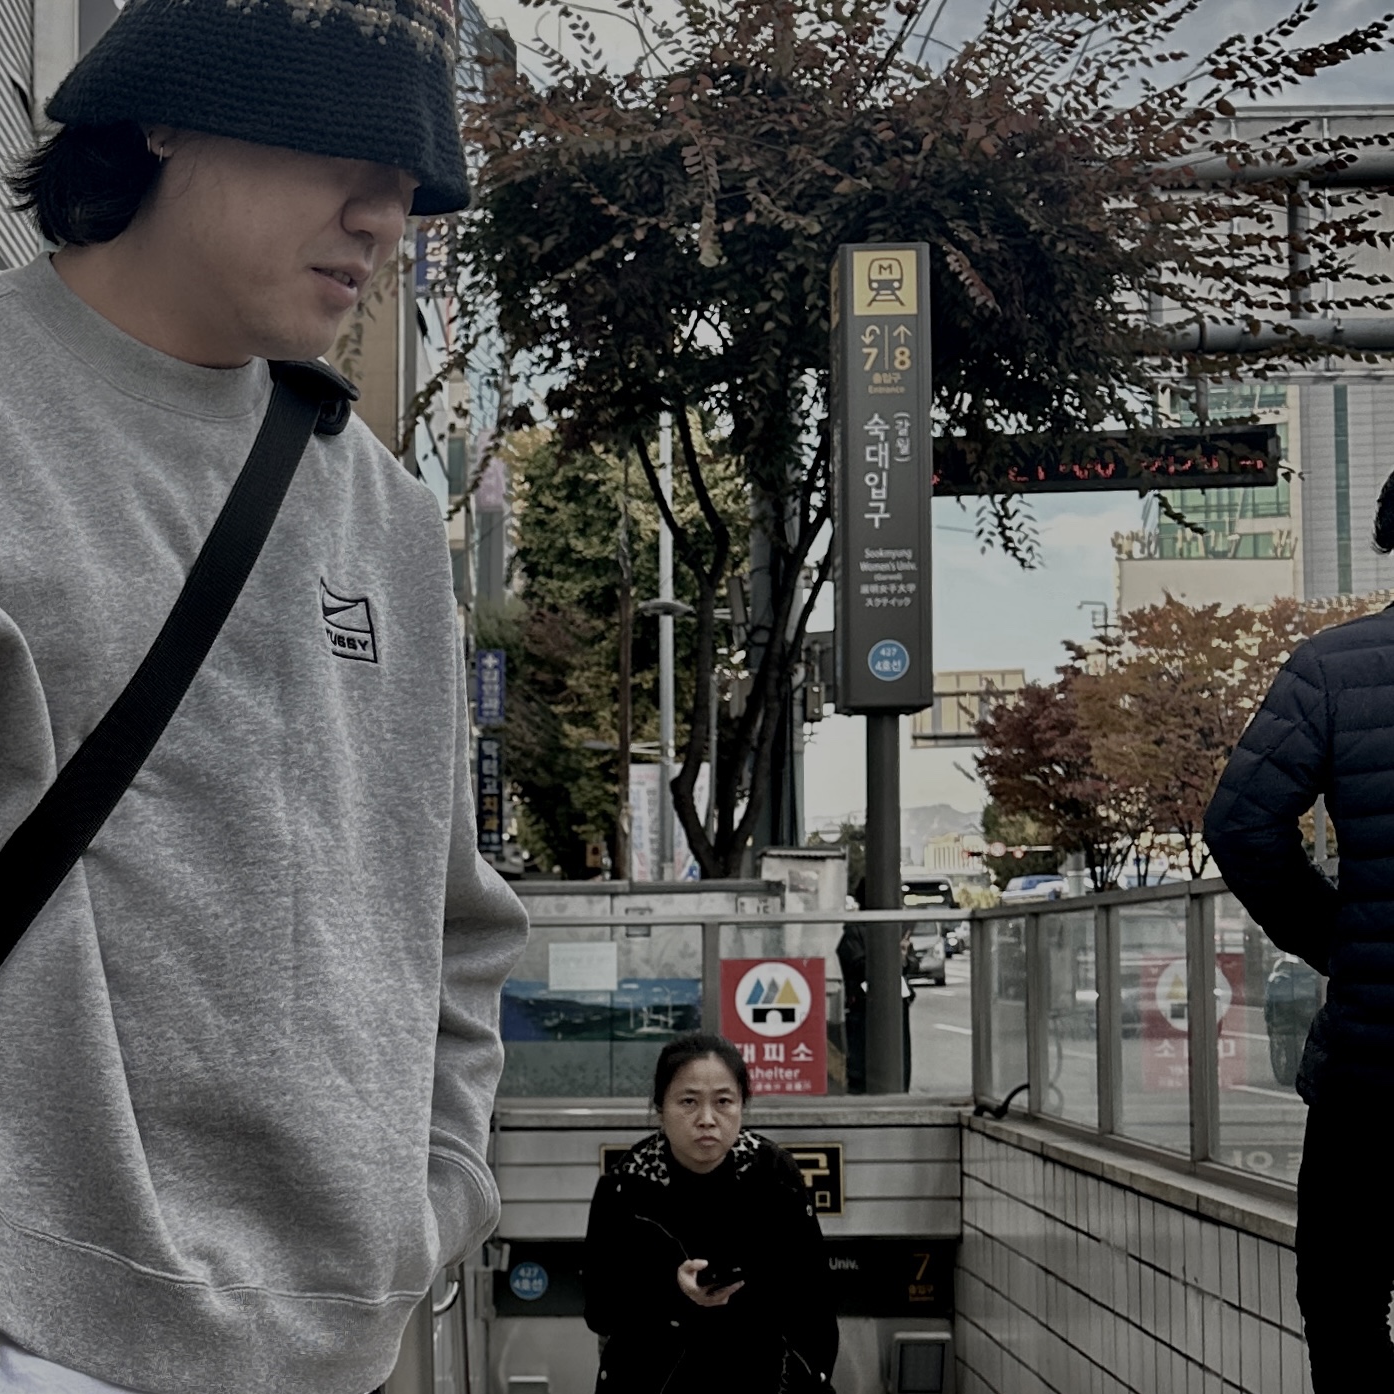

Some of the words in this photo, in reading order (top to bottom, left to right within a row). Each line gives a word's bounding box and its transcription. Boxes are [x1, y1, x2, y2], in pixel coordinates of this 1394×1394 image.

[862, 347, 879, 371] 7
[893, 346, 912, 371] 8
[863, 413, 892, 530] 숙대입구
[828, 1256, 860, 1271] Univ.
[912, 1253, 931, 1281] 7
